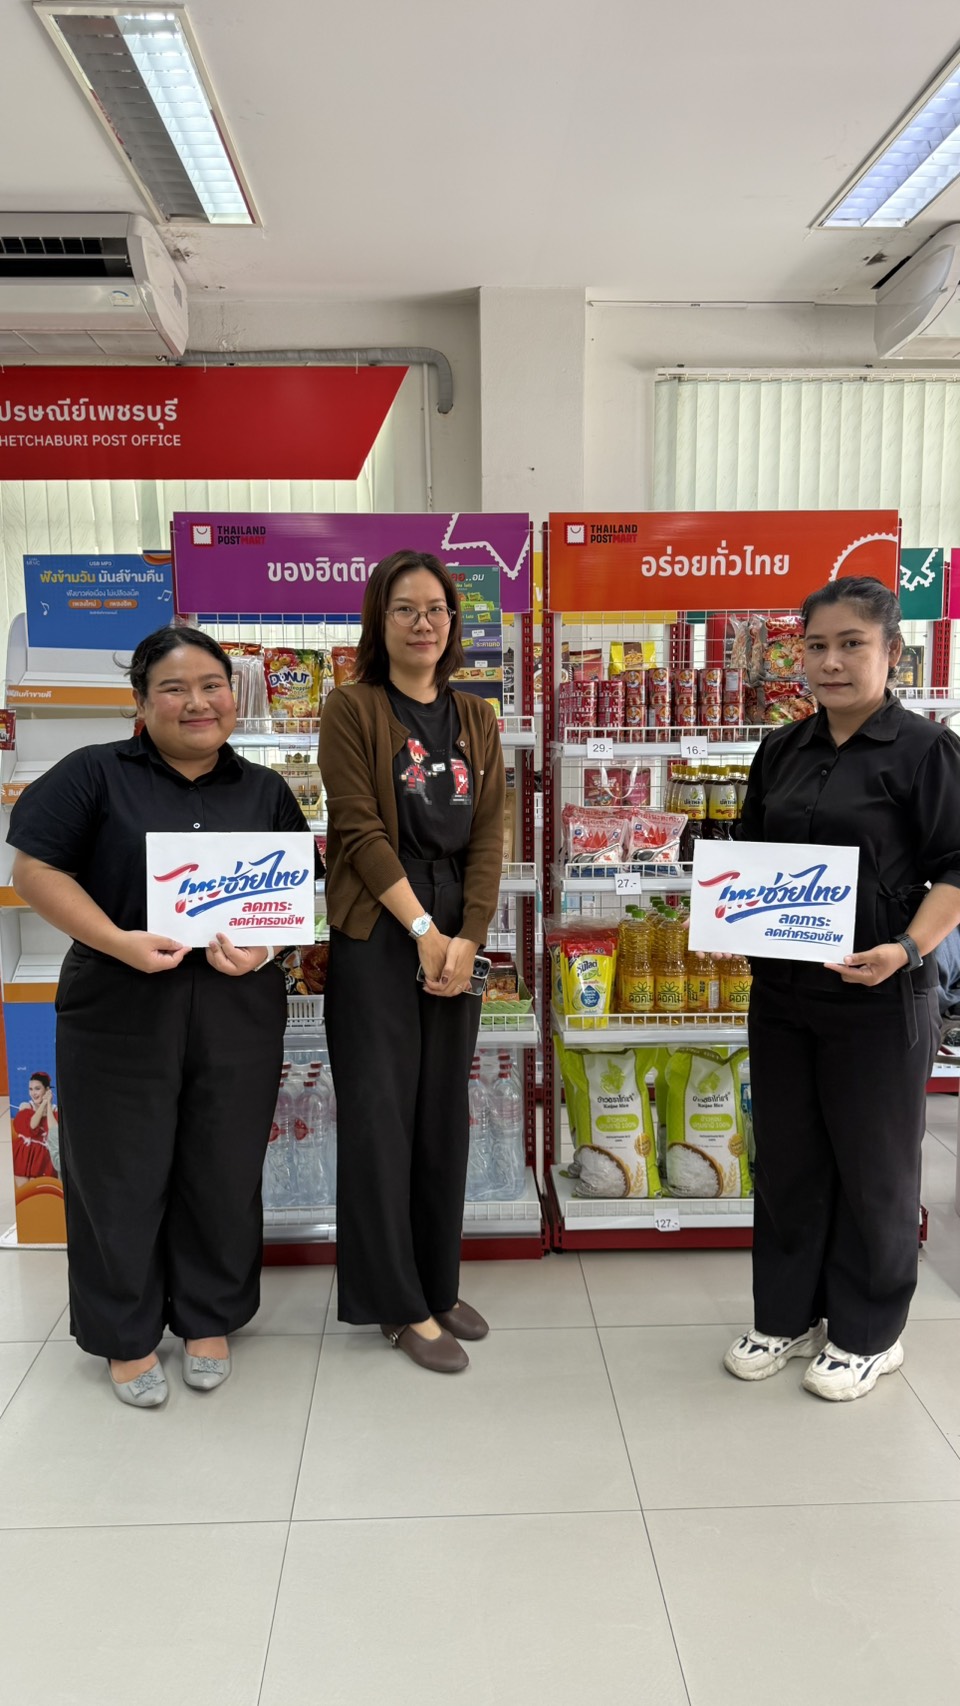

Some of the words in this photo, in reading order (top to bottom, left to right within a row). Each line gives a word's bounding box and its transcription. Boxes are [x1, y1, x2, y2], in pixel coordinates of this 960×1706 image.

[93, 435, 127, 446] POST
[131, 435, 181, 446] OFFICE
[217, 526, 266, 535] THAILAND
[590, 524, 638, 534] THAILAND
[218, 536, 266, 545] POSTMART
[590, 535, 637, 543] POSTMART
[641, 540, 790, 577] อร่อยทั่วไทย
[40, 570, 96, 583] ฟังข้ามวัน
[98, 569, 164, 583] มันส์ข้ามคืน
[269, 671, 310, 686] DONUT
[592, 744, 613, 753] 29.-
[686, 746, 706, 755] 16.-
[153, 850, 309, 914] ไทยช่วยไทย
[617, 879, 637, 888] 27.-
[698, 864, 852, 919] ไทยช่วยไทย
[242, 901, 293, 912] ลดภาระ
[229, 914, 305, 926] ลดค่าครองชีพ
[778, 914, 832, 927] ลดภาระ
[764, 927, 844, 943] ลดค่าครองชีพ
